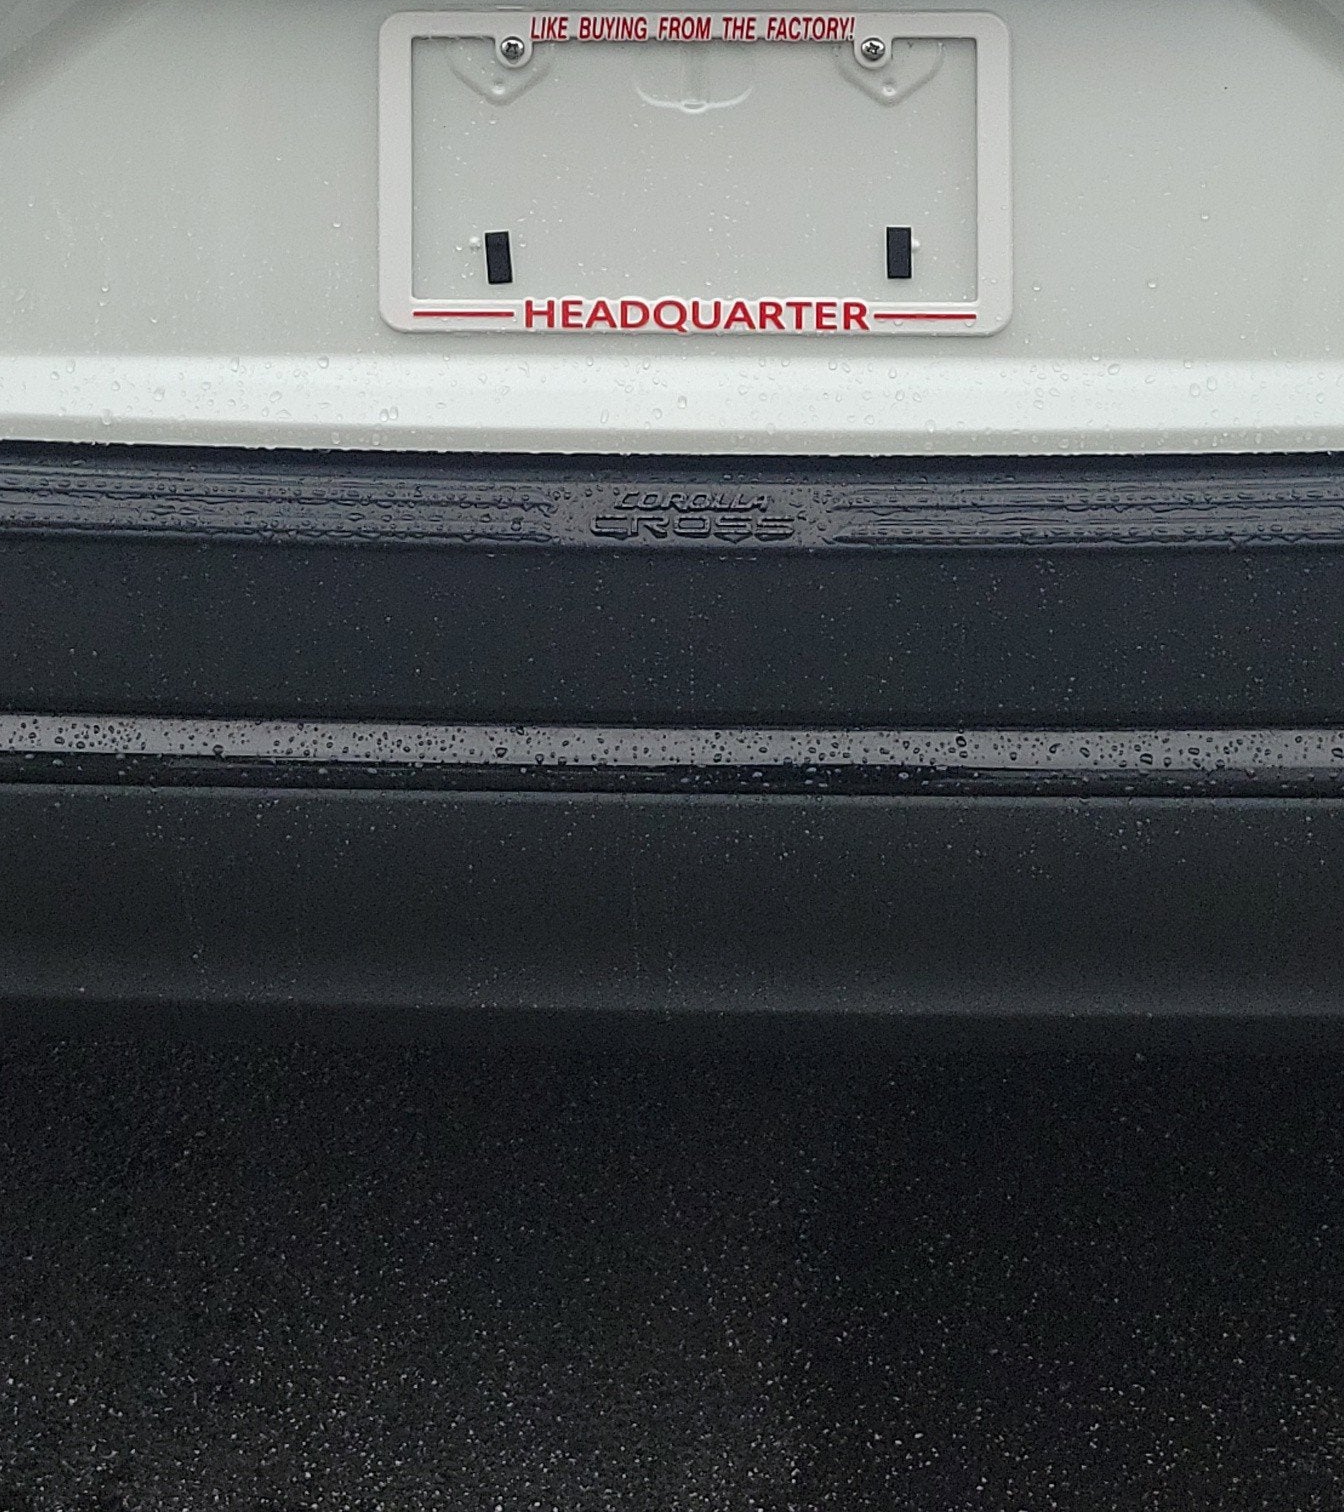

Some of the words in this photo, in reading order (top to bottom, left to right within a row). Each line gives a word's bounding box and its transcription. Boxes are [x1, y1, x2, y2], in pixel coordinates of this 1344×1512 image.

[531, 16, 568, 39] LIKE
[579, 16, 647, 39] BUYING
[659, 16, 712, 39] FROM
[723, 16, 755, 39] THE
[766, 16, 855, 39] FACTORY!
[524, 300, 871, 332] HEADQUARTER
[616, 492, 769, 512] COROLLA
[590, 515, 795, 539] CROSS
